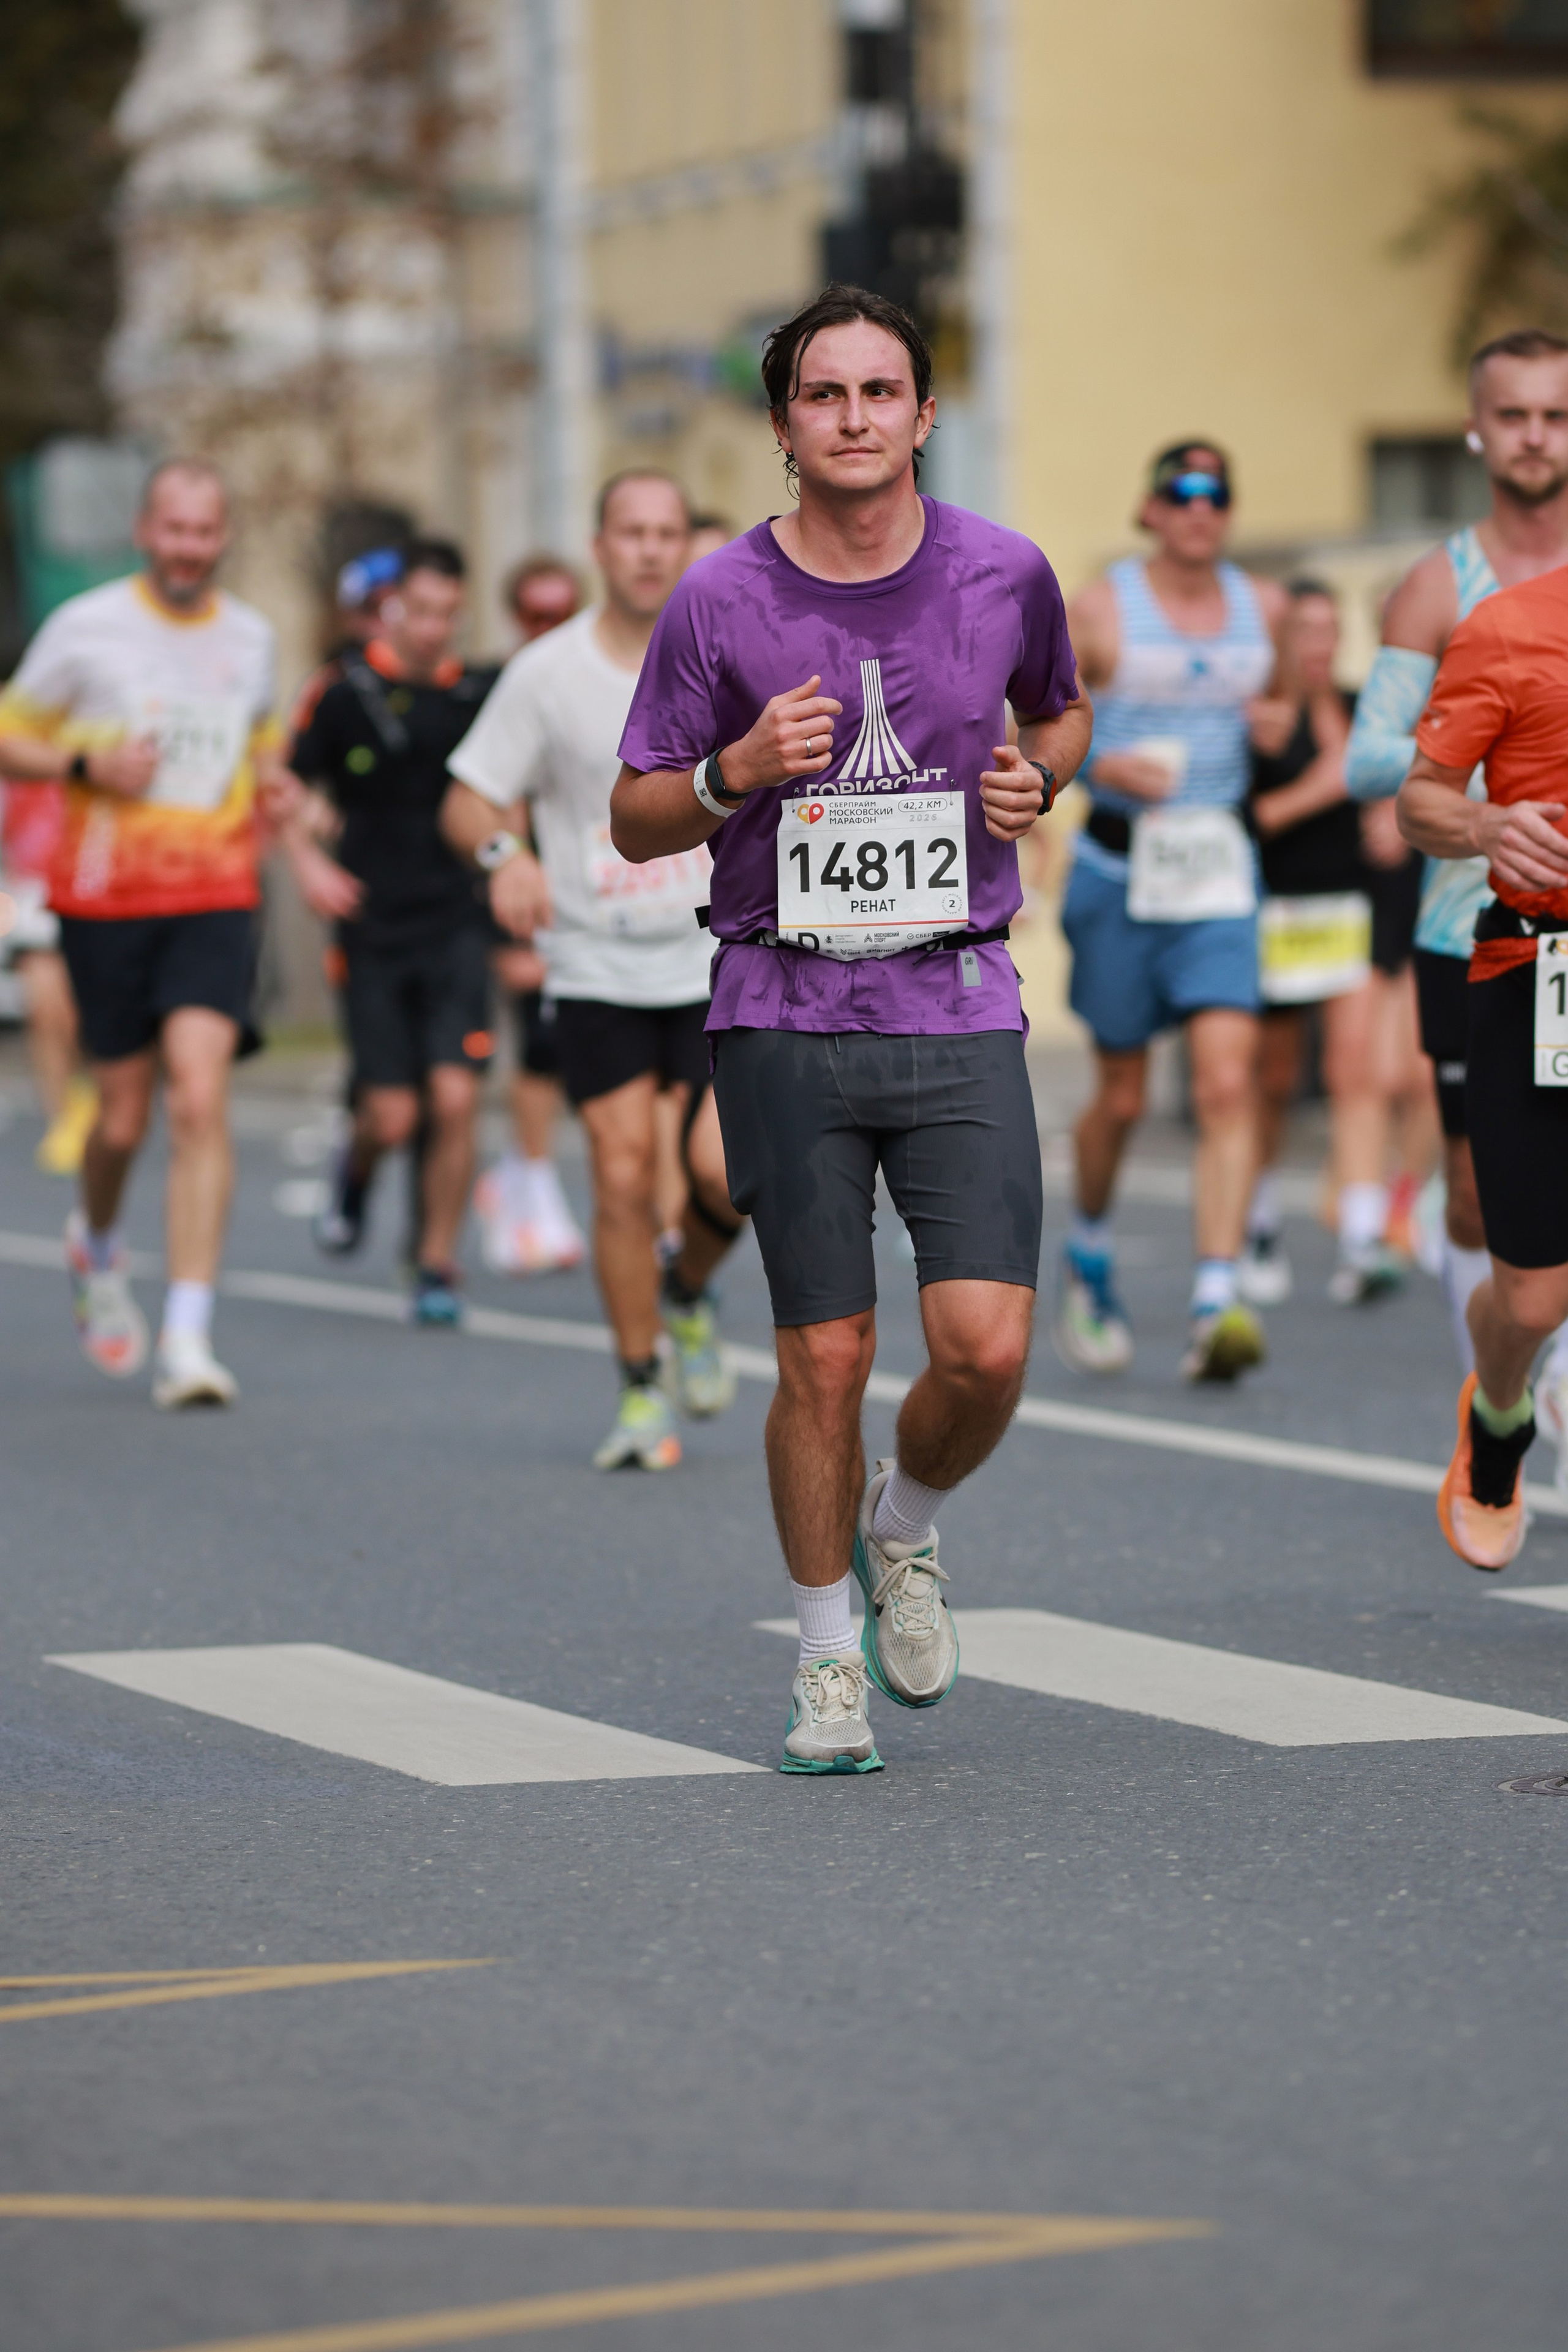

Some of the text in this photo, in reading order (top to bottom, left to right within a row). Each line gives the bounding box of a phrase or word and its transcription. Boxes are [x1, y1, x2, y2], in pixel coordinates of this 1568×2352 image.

[903, 802, 924, 810] 42,2
[829, 807, 893, 816] МОСКОВСКИЙ
[909, 813, 937, 822] 2026
[790, 837, 959, 892] 14812
[851, 899, 896, 913] РЕНАТ
[949, 899, 956, 908] 2
